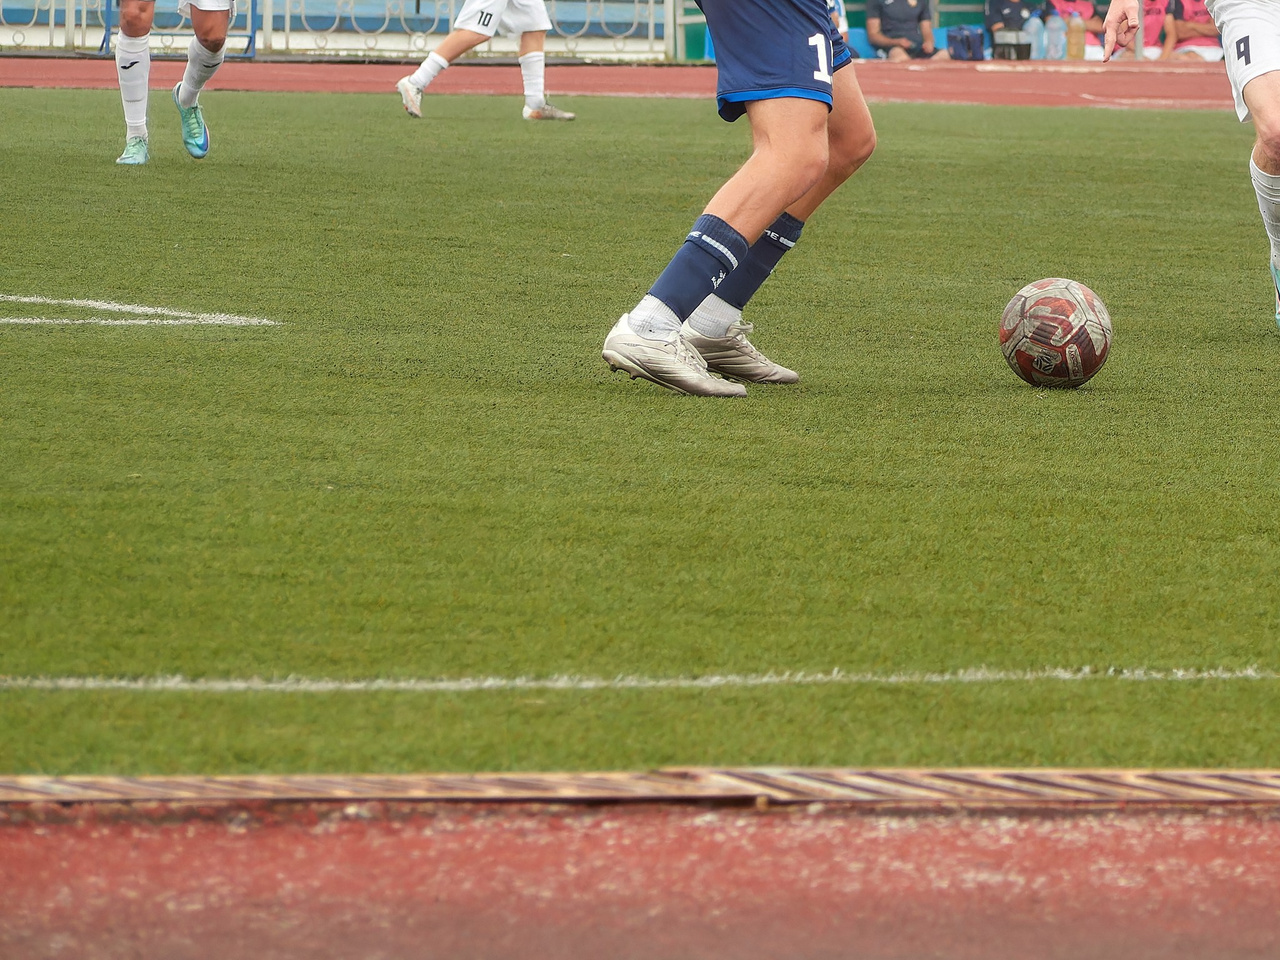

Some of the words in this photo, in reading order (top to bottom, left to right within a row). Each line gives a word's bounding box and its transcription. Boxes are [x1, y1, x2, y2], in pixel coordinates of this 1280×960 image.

[477, 10, 493, 27] 10
[808, 33, 834, 85] 1
[1235, 35, 1251, 66] 9
